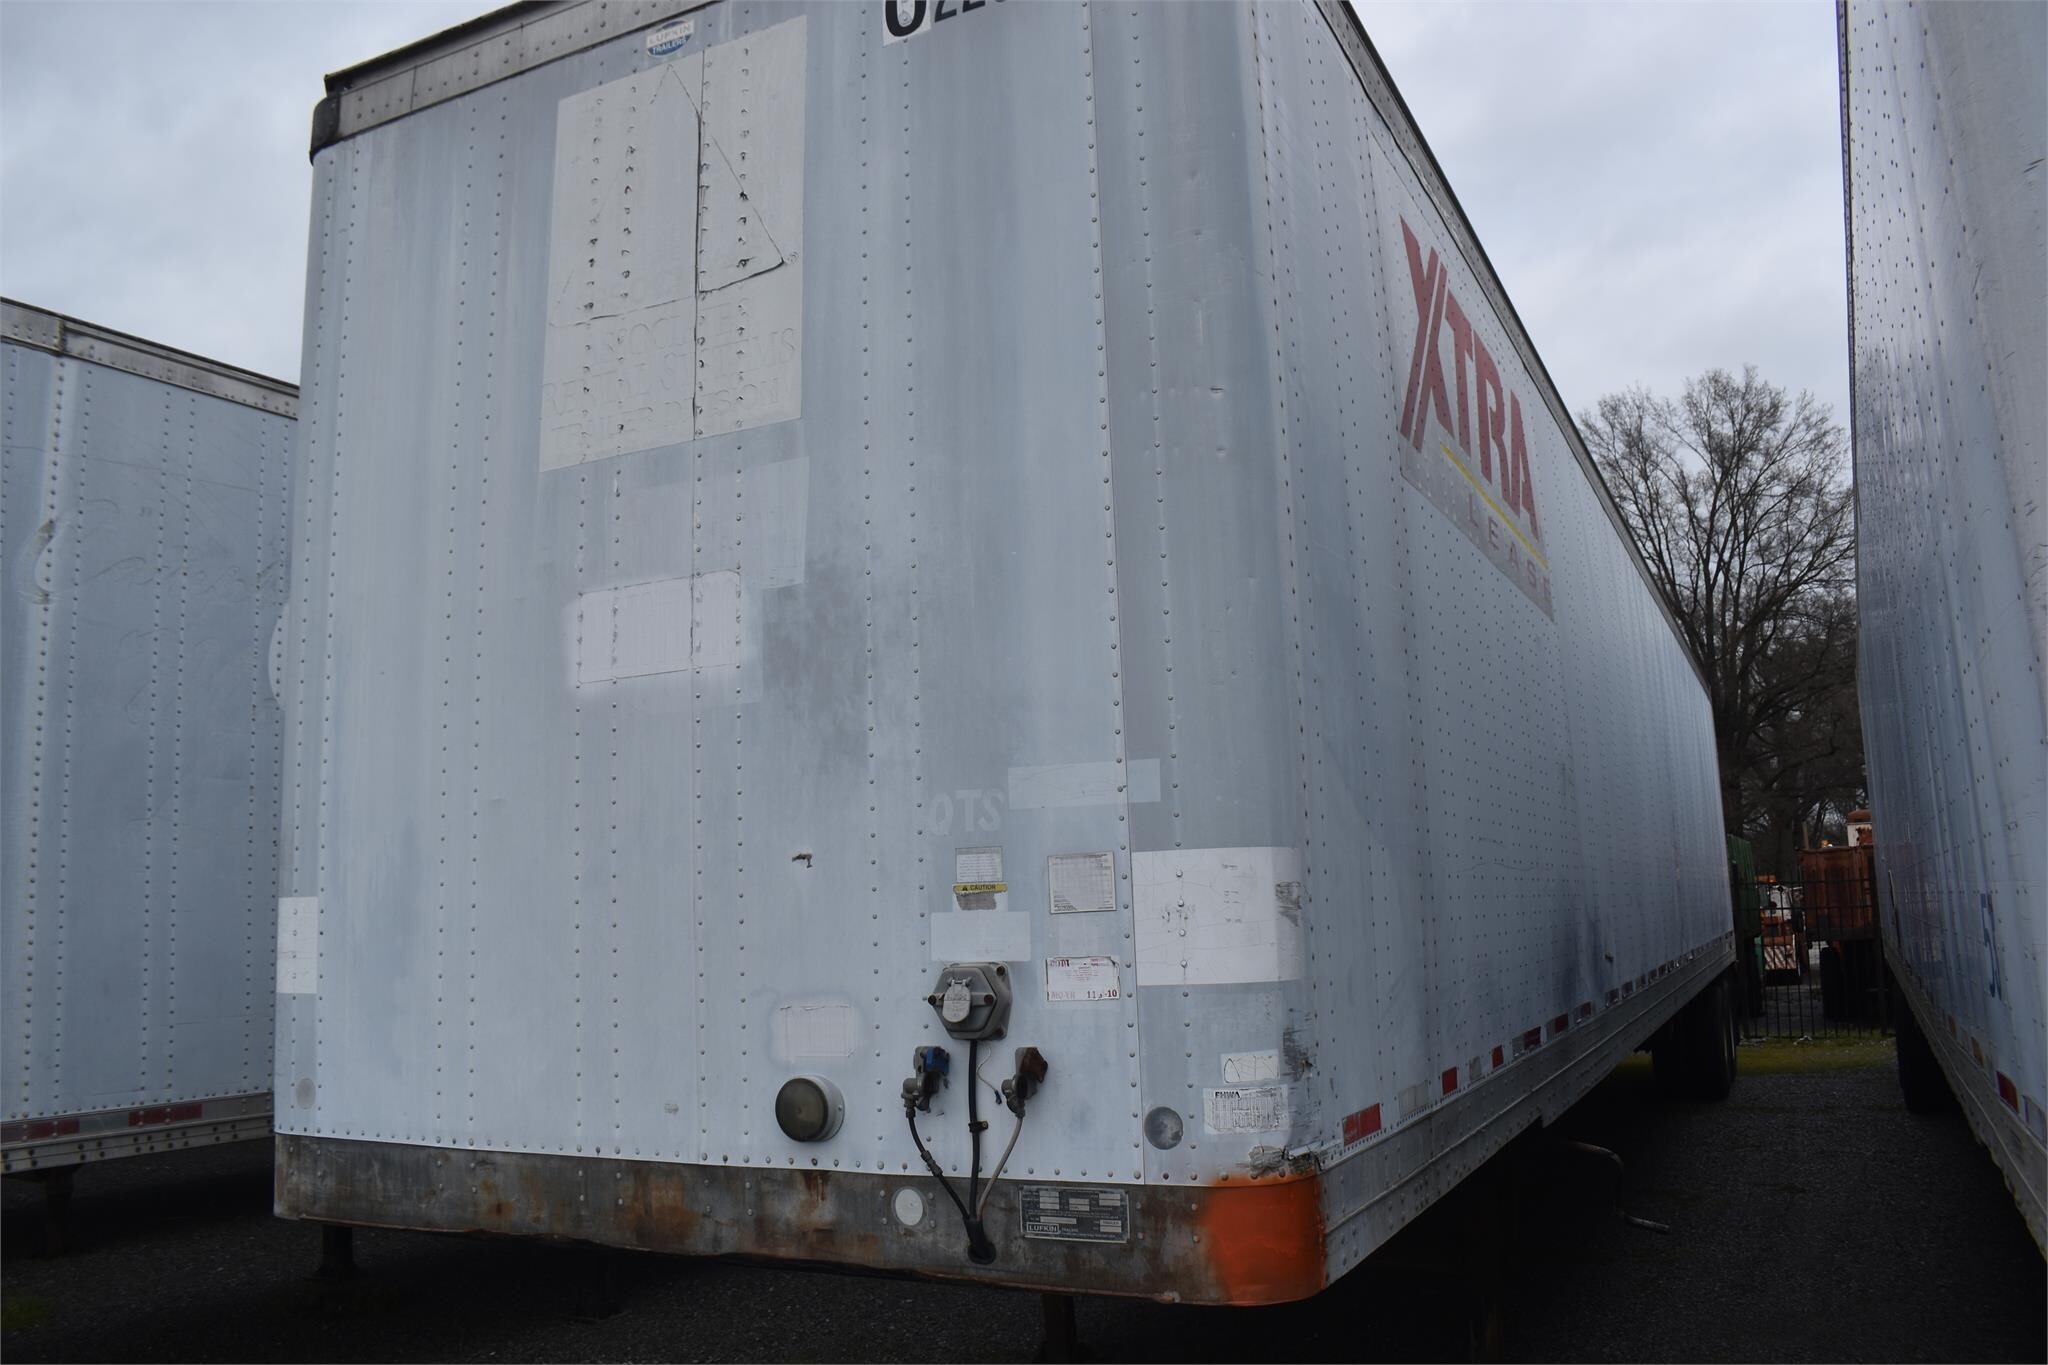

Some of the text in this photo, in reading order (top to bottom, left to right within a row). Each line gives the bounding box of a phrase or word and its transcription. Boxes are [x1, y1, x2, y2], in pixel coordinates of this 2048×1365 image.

[652, 37, 687, 54] TRAILERS
[1399, 214, 1541, 542] XTRA
[1028, 1224, 1057, 1232] LUFKIN
